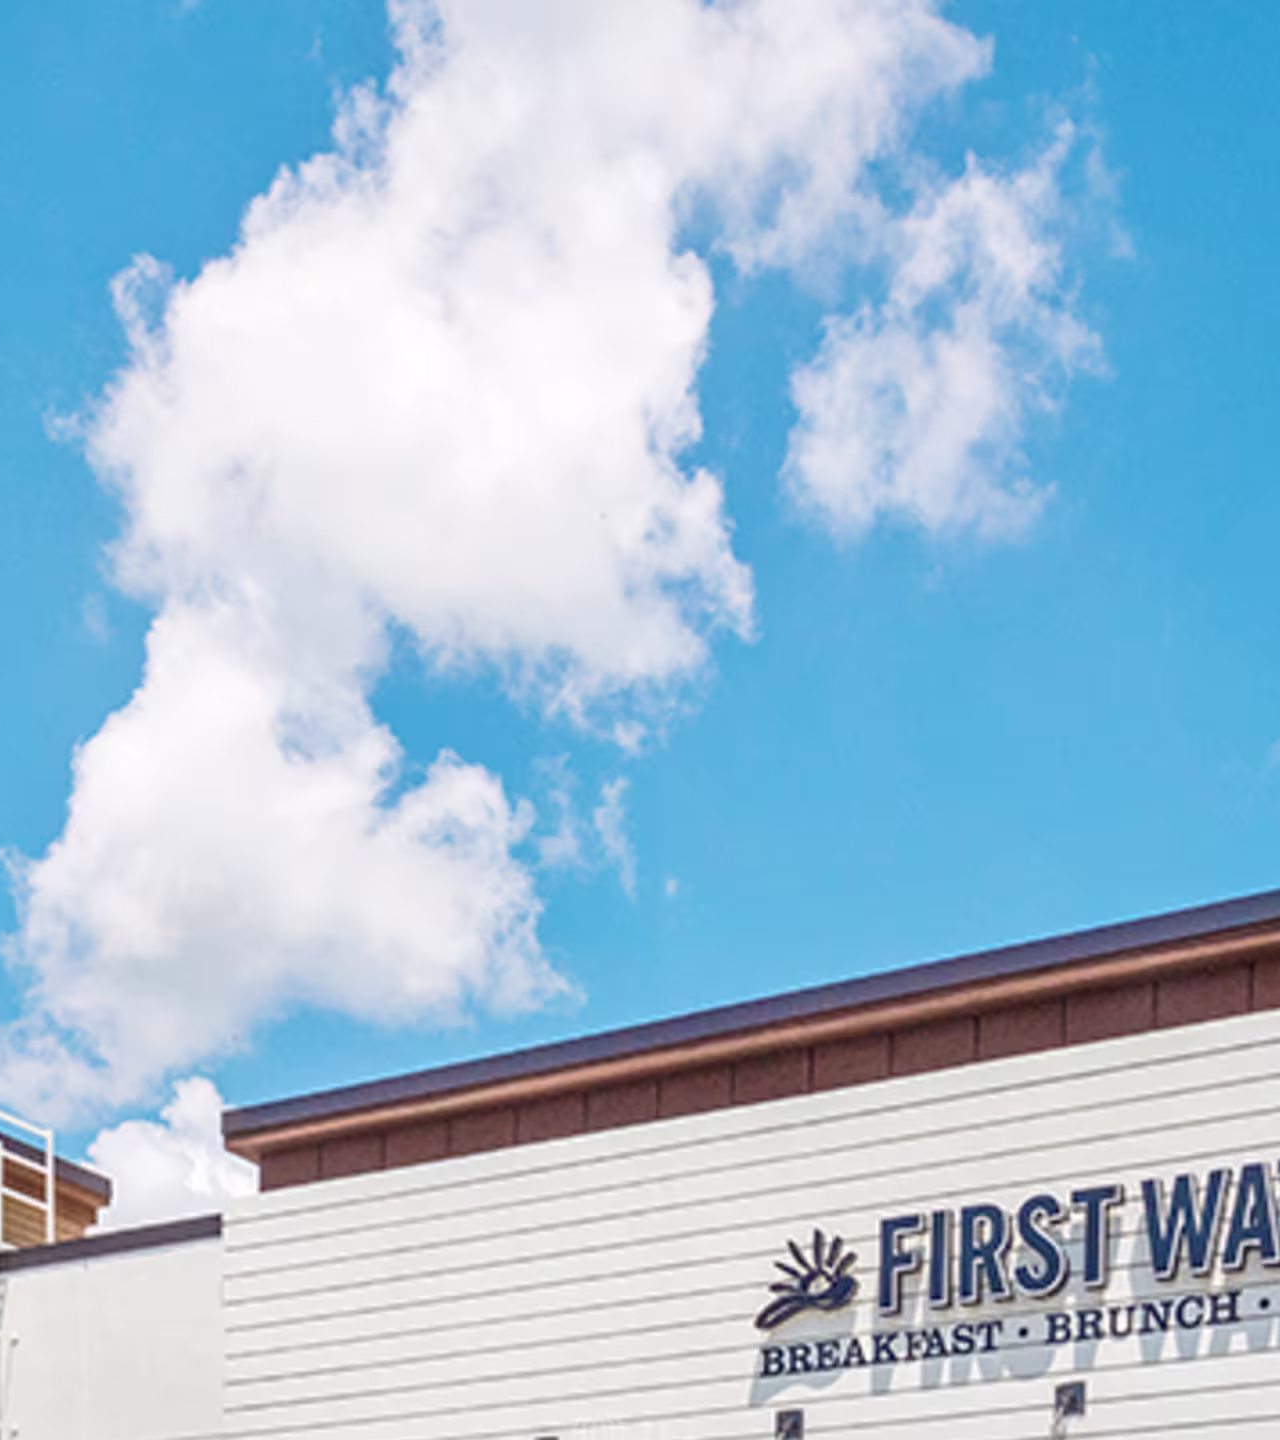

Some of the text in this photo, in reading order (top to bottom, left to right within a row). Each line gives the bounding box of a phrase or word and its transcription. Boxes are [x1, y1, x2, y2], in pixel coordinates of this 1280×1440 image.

[878, 1183, 1124, 1318] FIRST
[760, 1320, 1004, 1378] BREAKFAST
[1045, 1290, 1242, 1345] BRUNCH
